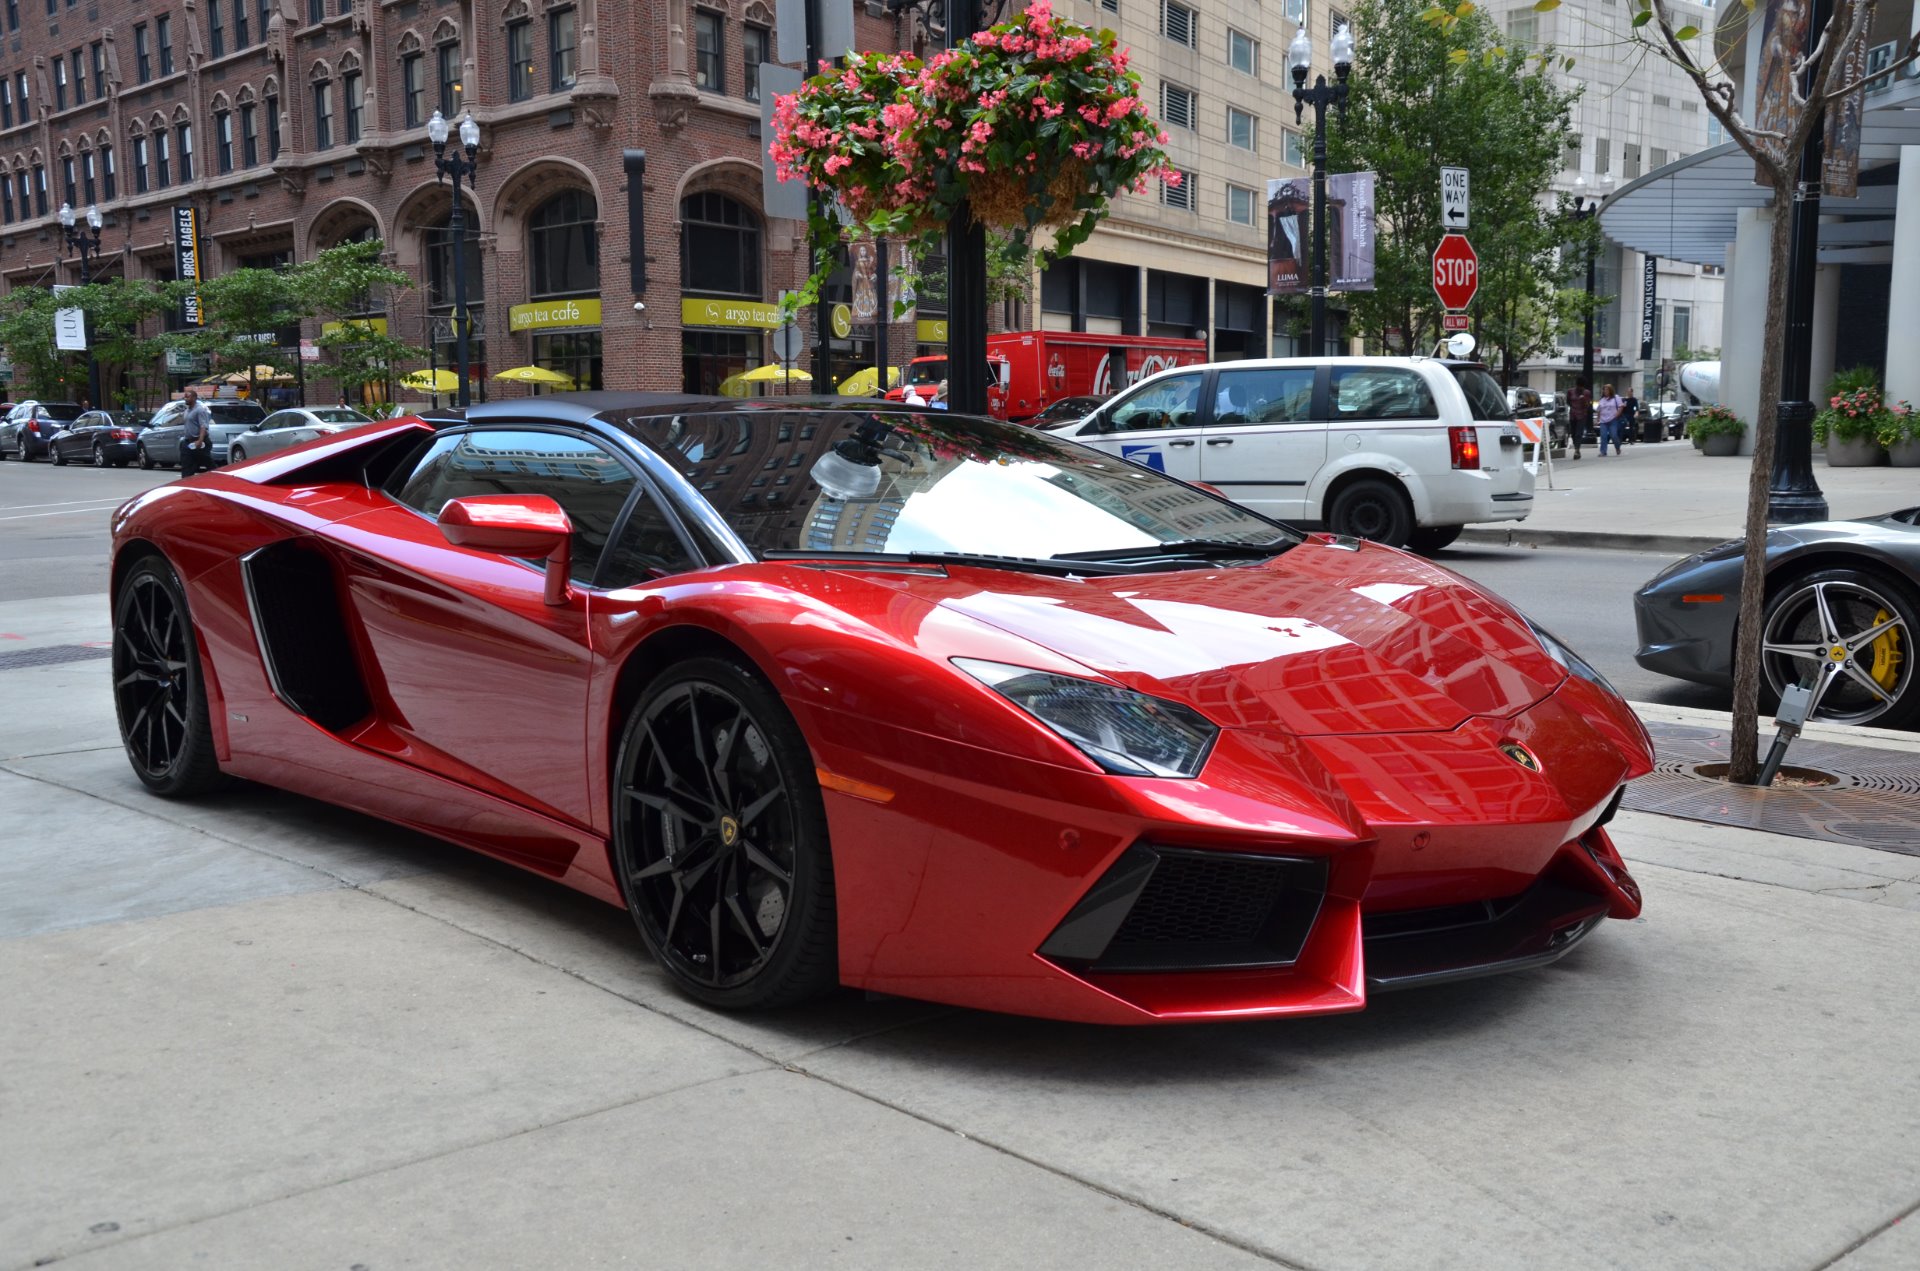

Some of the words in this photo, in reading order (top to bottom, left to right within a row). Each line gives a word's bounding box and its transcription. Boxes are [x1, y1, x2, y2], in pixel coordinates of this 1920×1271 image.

[1845, 51, 1856, 114] Coloial
[1445, 173, 1465, 188] ONE
[1445, 190, 1466, 204] WAY
[179, 209, 194, 247] BAGELS
[182, 249, 195, 276] BROS.
[1436, 258, 1475, 286] STOP
[1277, 273, 1299, 281] LUMA
[1645, 260, 1654, 317] NORDSTROM
[518, 311, 533, 328] argo
[535, 308, 549, 322] tea
[551, 301, 580, 321] café
[725, 308, 751, 325] argo
[752, 308, 765, 322] tea
[1446, 317, 1456, 327] ALL
[1456, 317, 1467, 327] WAY
[1642, 319, 1653, 343] rack
[1607, 352, 1624, 365] rack
